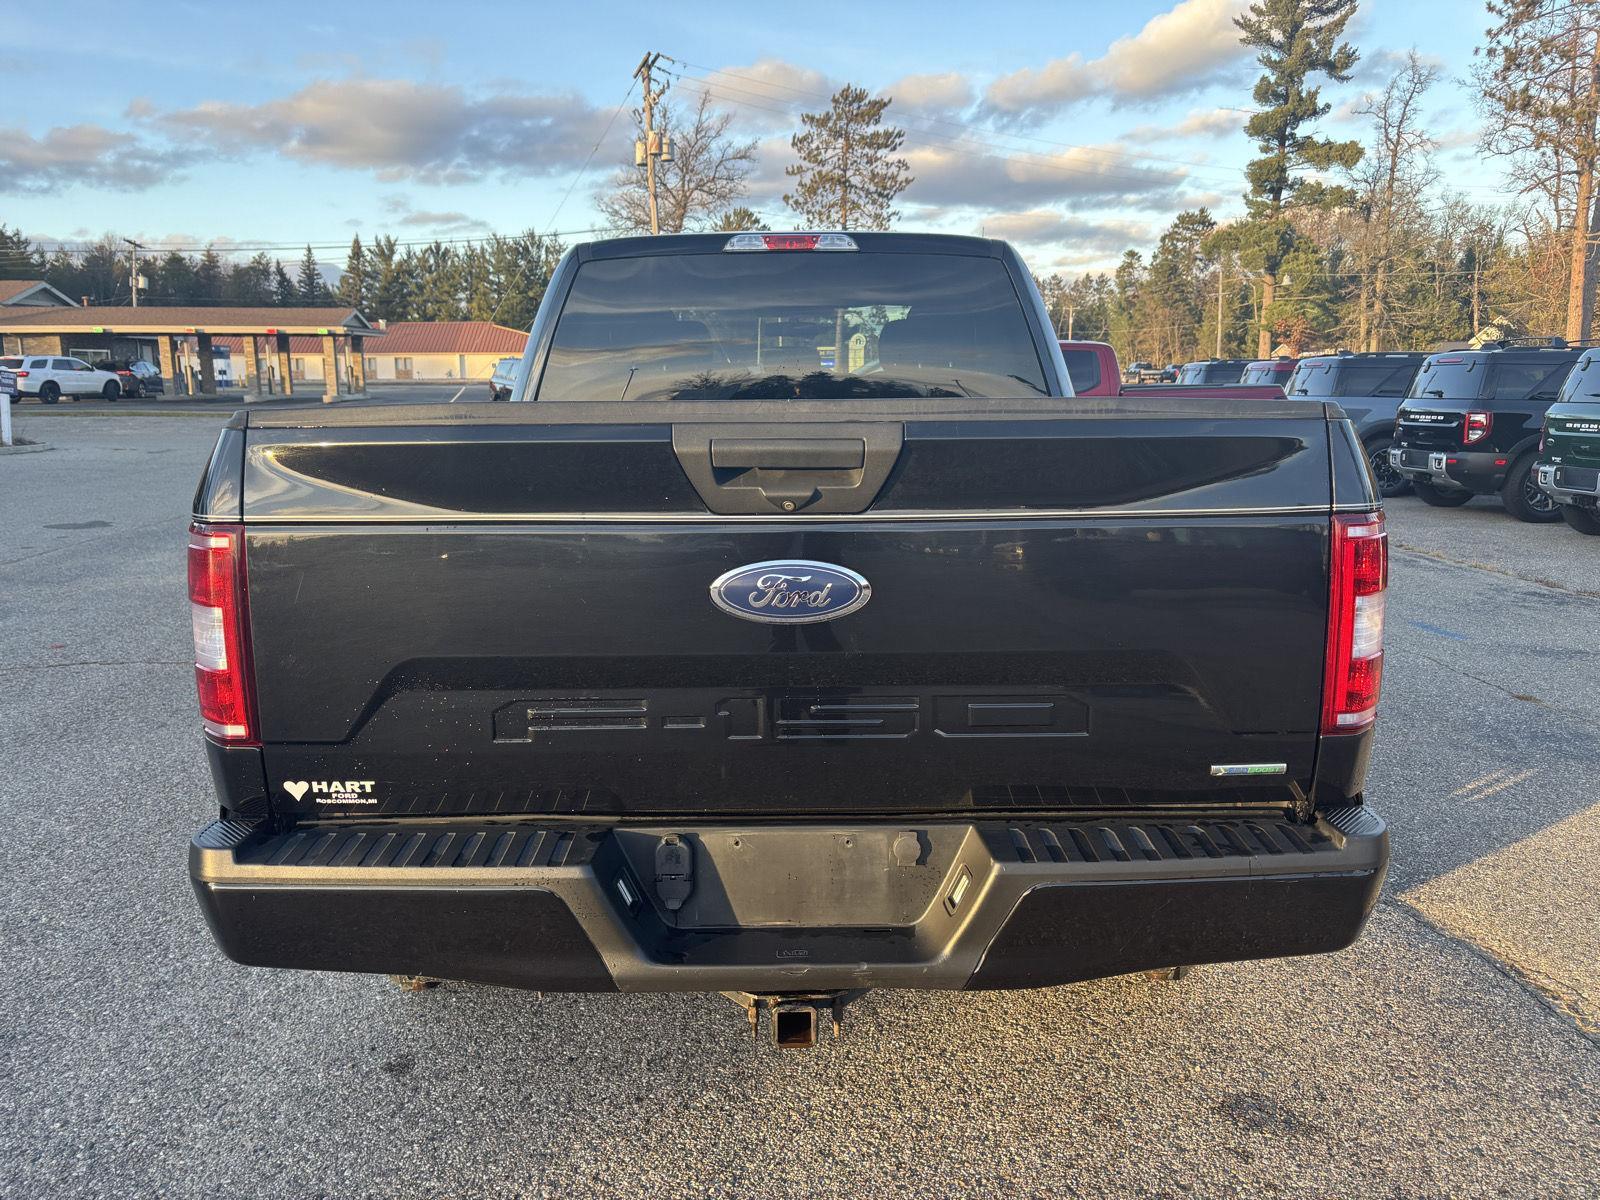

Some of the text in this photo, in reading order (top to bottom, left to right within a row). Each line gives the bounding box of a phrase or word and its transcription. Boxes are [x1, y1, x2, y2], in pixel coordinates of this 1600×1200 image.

[748, 573, 833, 609] Ford
[492, 695, 1091, 744] F-150
[311, 781, 376, 793] HART
